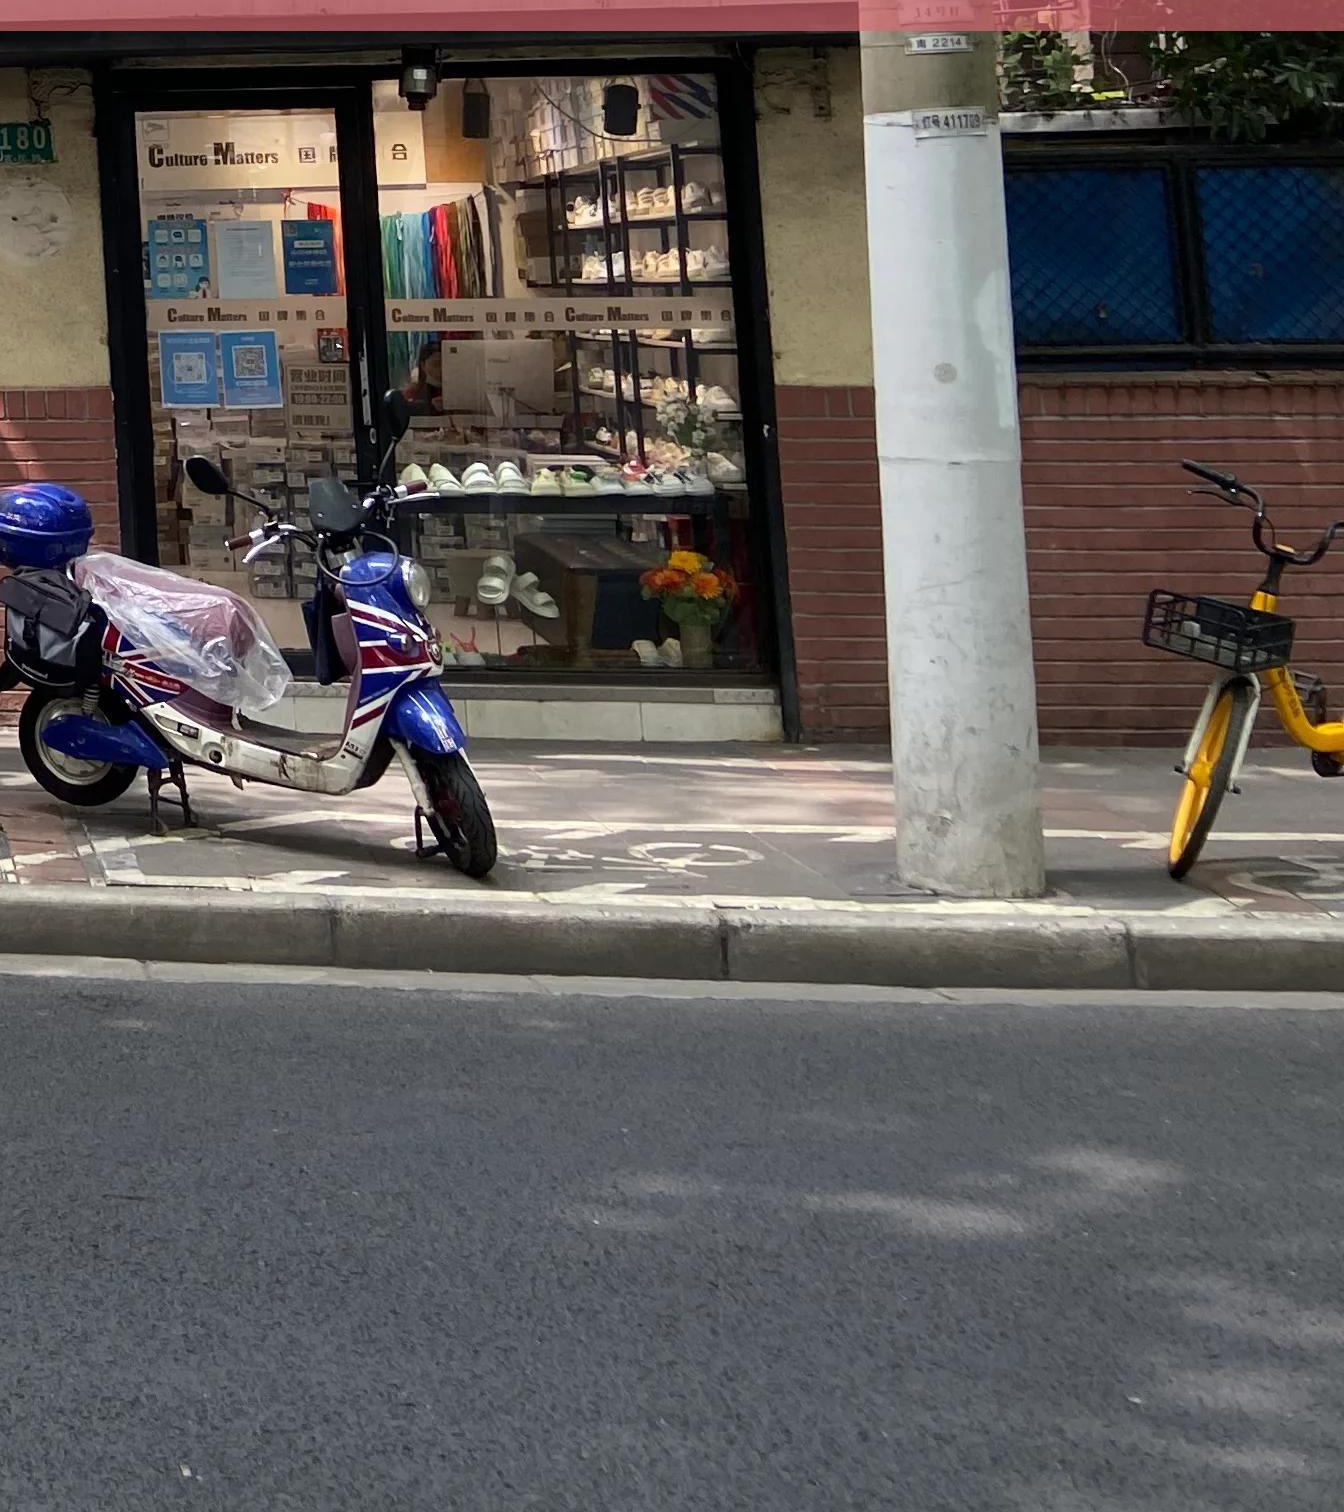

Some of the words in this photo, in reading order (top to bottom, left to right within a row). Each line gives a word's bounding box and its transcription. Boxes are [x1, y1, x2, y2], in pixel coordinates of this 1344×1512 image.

[932, 37, 962, 49] 2214
[0, 127, 46, 150] 180
[148, 144, 209, 168] Culture
[213, 141, 279, 166] Matters
